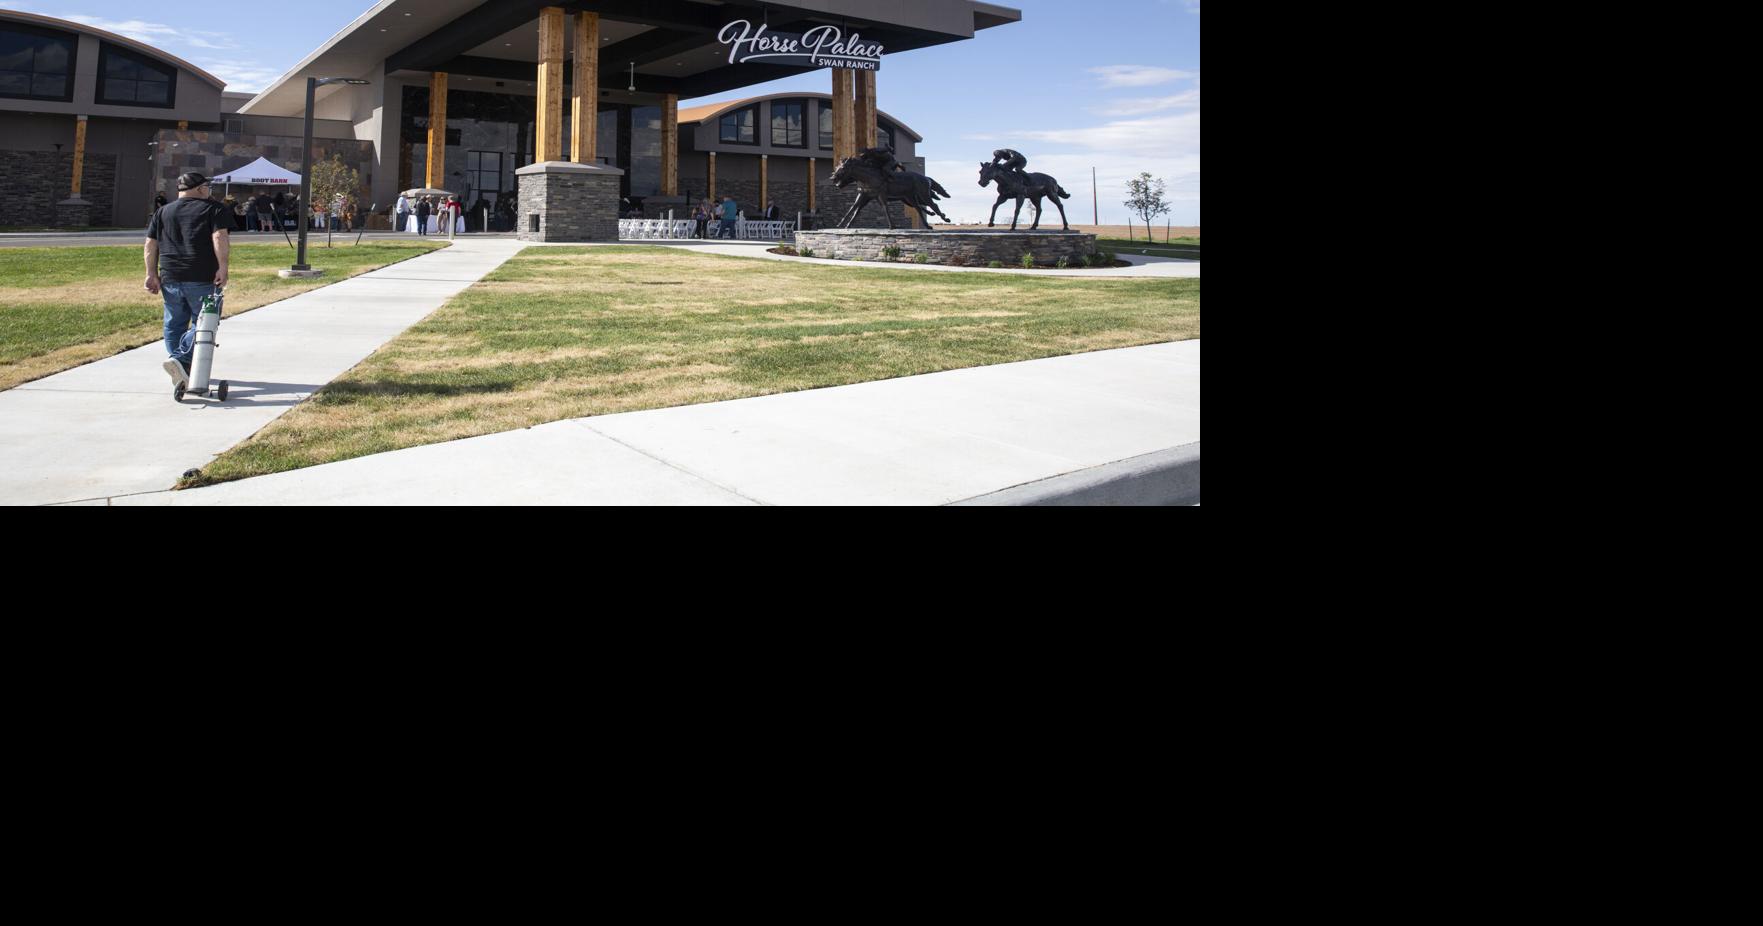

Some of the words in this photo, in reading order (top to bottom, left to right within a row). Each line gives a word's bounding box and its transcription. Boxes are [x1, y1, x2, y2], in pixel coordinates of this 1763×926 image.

[717, 19, 798, 64] Horse
[801, 25, 884, 63] Palace
[818, 58, 844, 68] SWAN
[847, 60, 875, 70] RANCH
